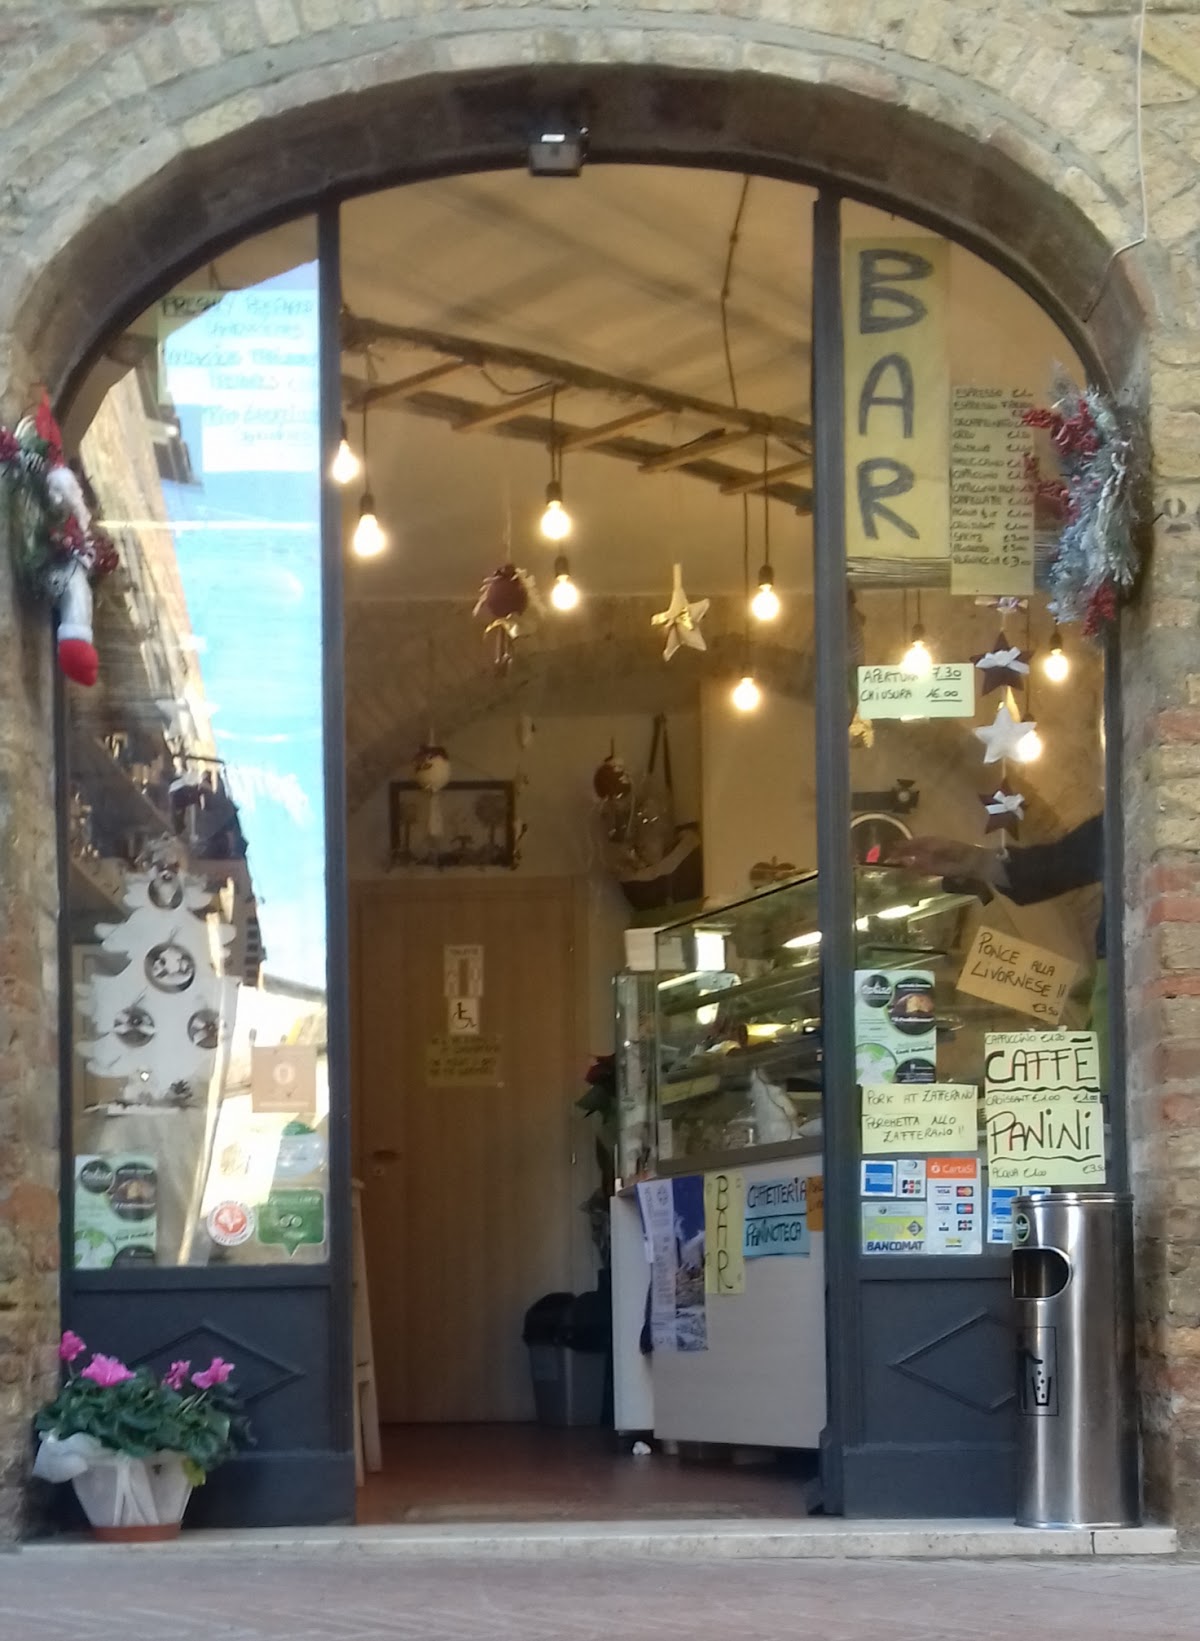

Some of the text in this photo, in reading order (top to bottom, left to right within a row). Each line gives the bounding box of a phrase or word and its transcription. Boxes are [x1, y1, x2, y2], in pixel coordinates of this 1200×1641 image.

[857, 248, 935, 540] BAR
[860, 687, 912, 701] CHIUSURA
[978, 931, 1055, 976] PONCE ALLA
[971, 960, 1052, 997] LIVORNESE
[985, 1033, 1036, 1044] CAPPUCCINO
[867, 1090, 894, 1104] PORK
[903, 1093, 919, 1103] AT
[931, 1115, 956, 1125] ALLO
[883, 1127, 953, 1143] ZAFFERANO
[986, 1108, 1091, 1154] PANINI
[715, 1175, 733, 1293] BAR
[867, 1241, 924, 1251] BANCOMAT
